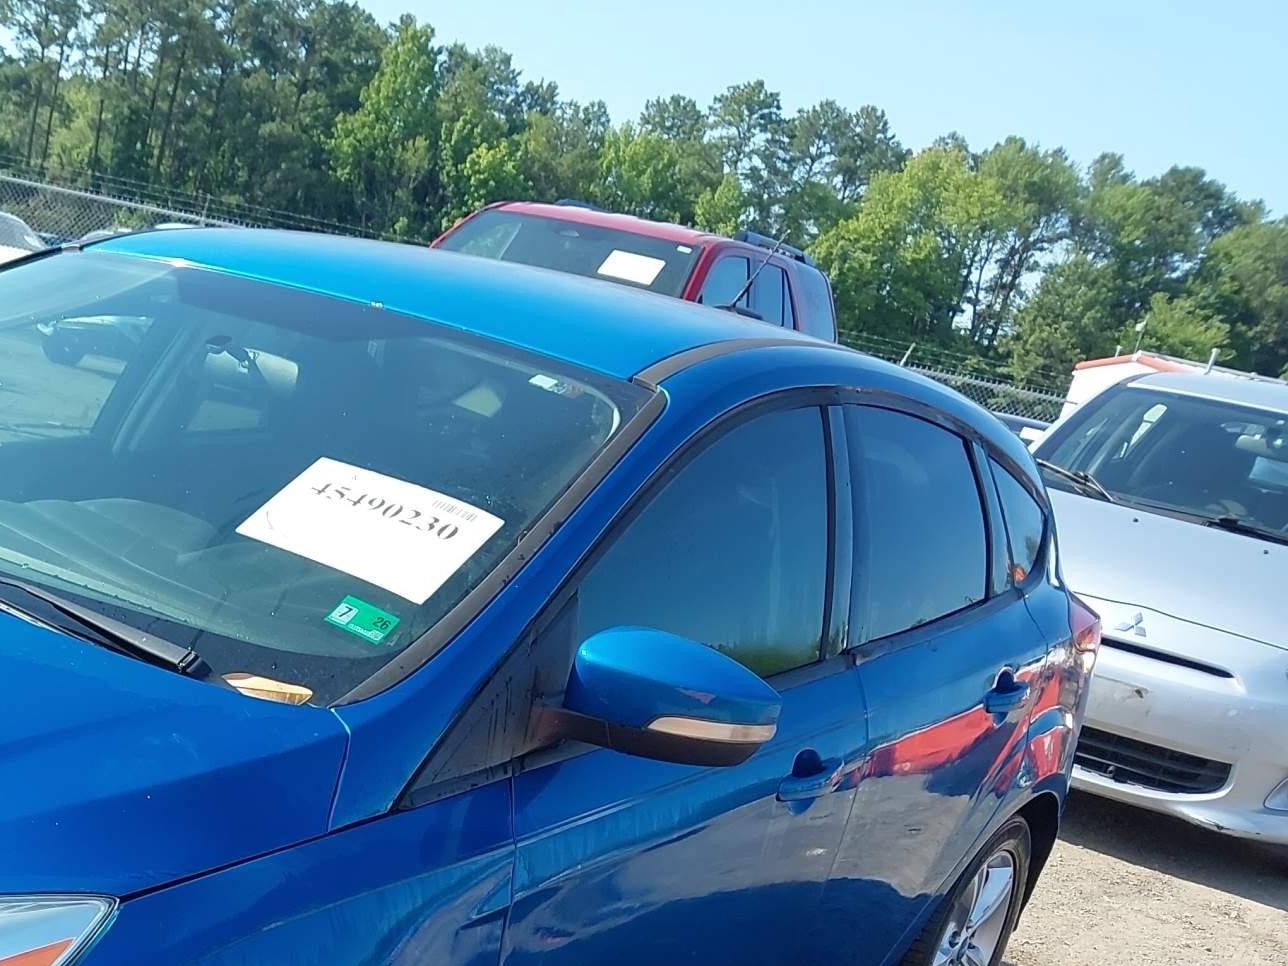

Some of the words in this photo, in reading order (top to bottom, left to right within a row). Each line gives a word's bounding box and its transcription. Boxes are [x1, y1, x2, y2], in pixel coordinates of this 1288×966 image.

[311, 482, 460, 540] 45490230
[338, 605, 354, 618] 7
[372, 616, 392, 630] 26
